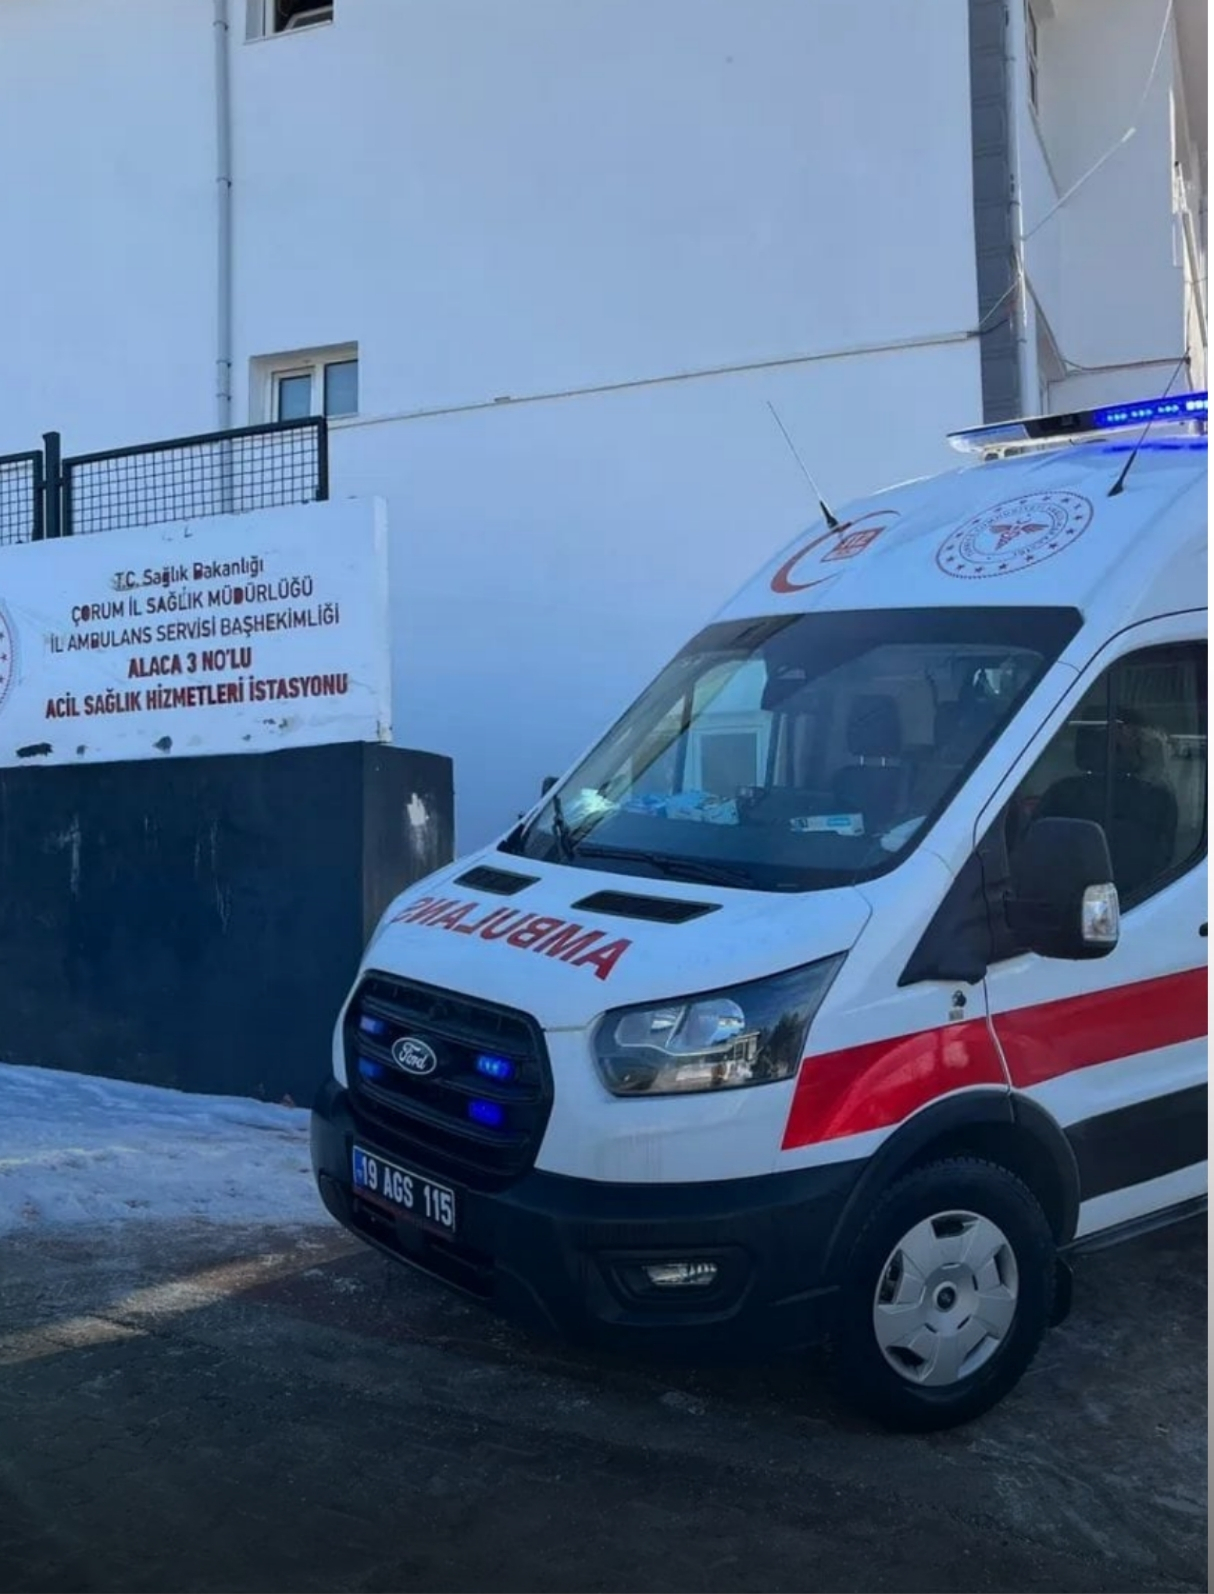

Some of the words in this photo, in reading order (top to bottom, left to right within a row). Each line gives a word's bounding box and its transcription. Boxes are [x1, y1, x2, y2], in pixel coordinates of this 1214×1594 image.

[143, 565, 188, 588] Sağlık
[193, 555, 264, 580] Bakanlığı
[71, 600, 124, 627] ÇORUM
[128, 595, 142, 616] İL
[146, 591, 204, 614] SAĞLIK
[208, 575, 312, 607] MÜDÜRLÜĞÜ
[51, 633, 64, 653] İL
[67, 626, 152, 651] AMBULANS
[156, 615, 216, 642] SERVİSİ
[220, 602, 339, 637] BAŞHEKİMLİĞİ
[128, 653, 182, 679] ALACA
[186, 652, 198, 673] 3
[202, 647, 252, 671] NO'LU
[45, 691, 81, 719] ACİL
[84, 687, 141, 716] SAĞLIK
[146, 675, 244, 710] HİZMETLERİ
[250, 675, 348, 702] İSTASYONU
[399, 1043, 428, 1070] Ford
[361, 1156, 378, 1190] 19
[383, 1166, 414, 1209] AGS
[423, 1184, 454, 1227] 115
